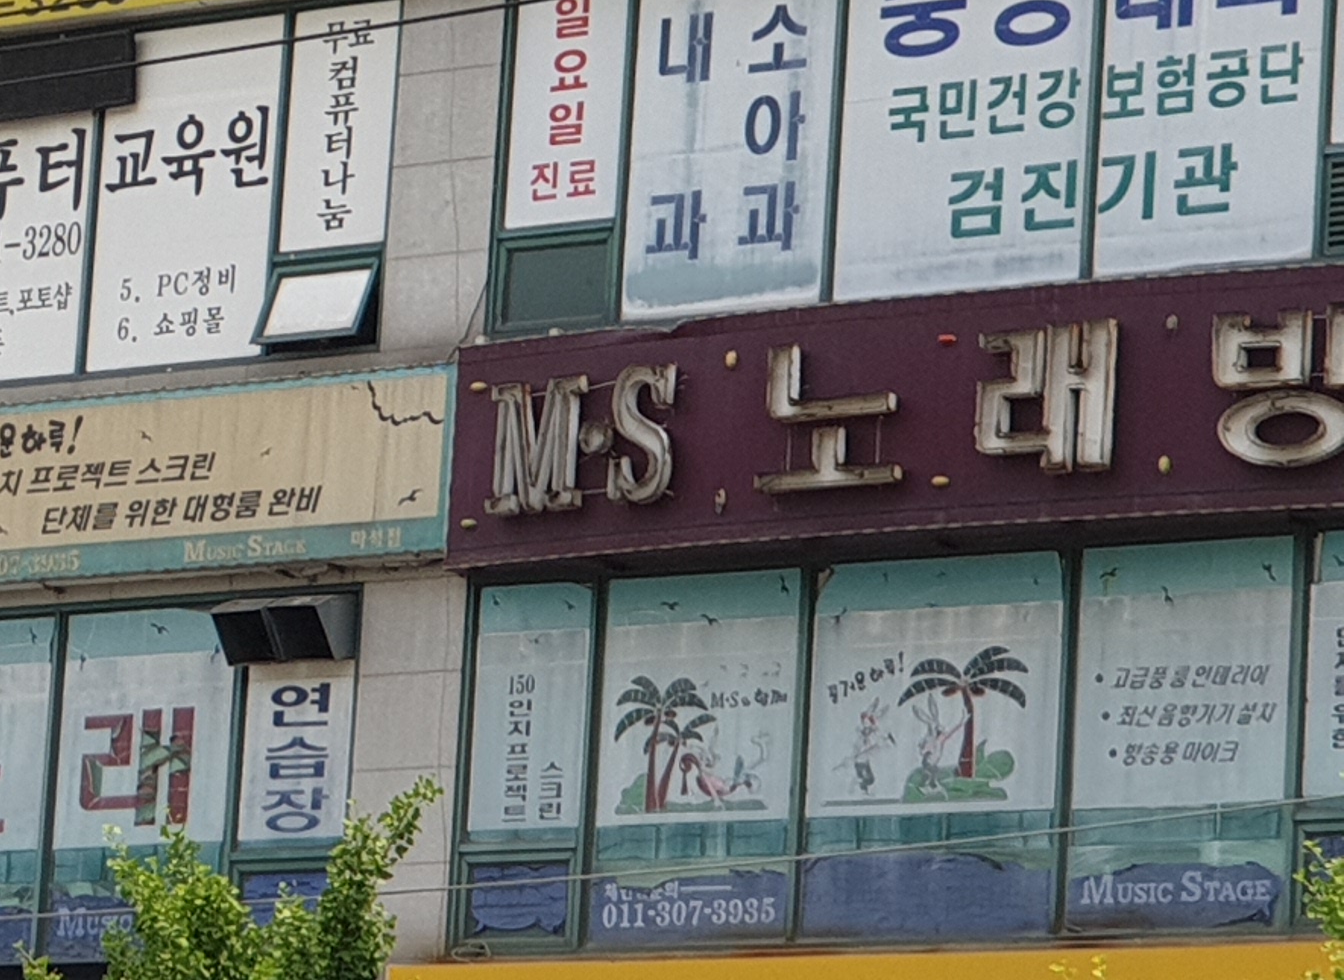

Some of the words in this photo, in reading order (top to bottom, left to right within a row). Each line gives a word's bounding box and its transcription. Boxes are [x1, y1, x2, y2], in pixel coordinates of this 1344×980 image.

[323, 18, 375, 55] 무료
[105, 105, 271, 197] 교육원
[316, 56, 359, 233] 컴퓨터나눔
[530, 159, 597, 202] 진료
[948, 143, 1238, 240] 검진기관
[119, 276, 141, 304] 5.
[157, 264, 237, 298] PC정비
[117, 317, 138, 343] 6.
[154, 305, 225, 337] 쇼핑몰
[21, 415, 85, 456] 하루!
[25, 458, 131, 493] 프로젝트
[135, 451, 217, 486] 스크린
[41, 502, 118, 536] 단체를
[124, 497, 178, 528] 위한
[182, 490, 263, 522] 대형룸
[268, 484, 323, 516] 완비
[260, 681, 330, 834] 연습장
[1180, 870, 1272, 903] STAGE
